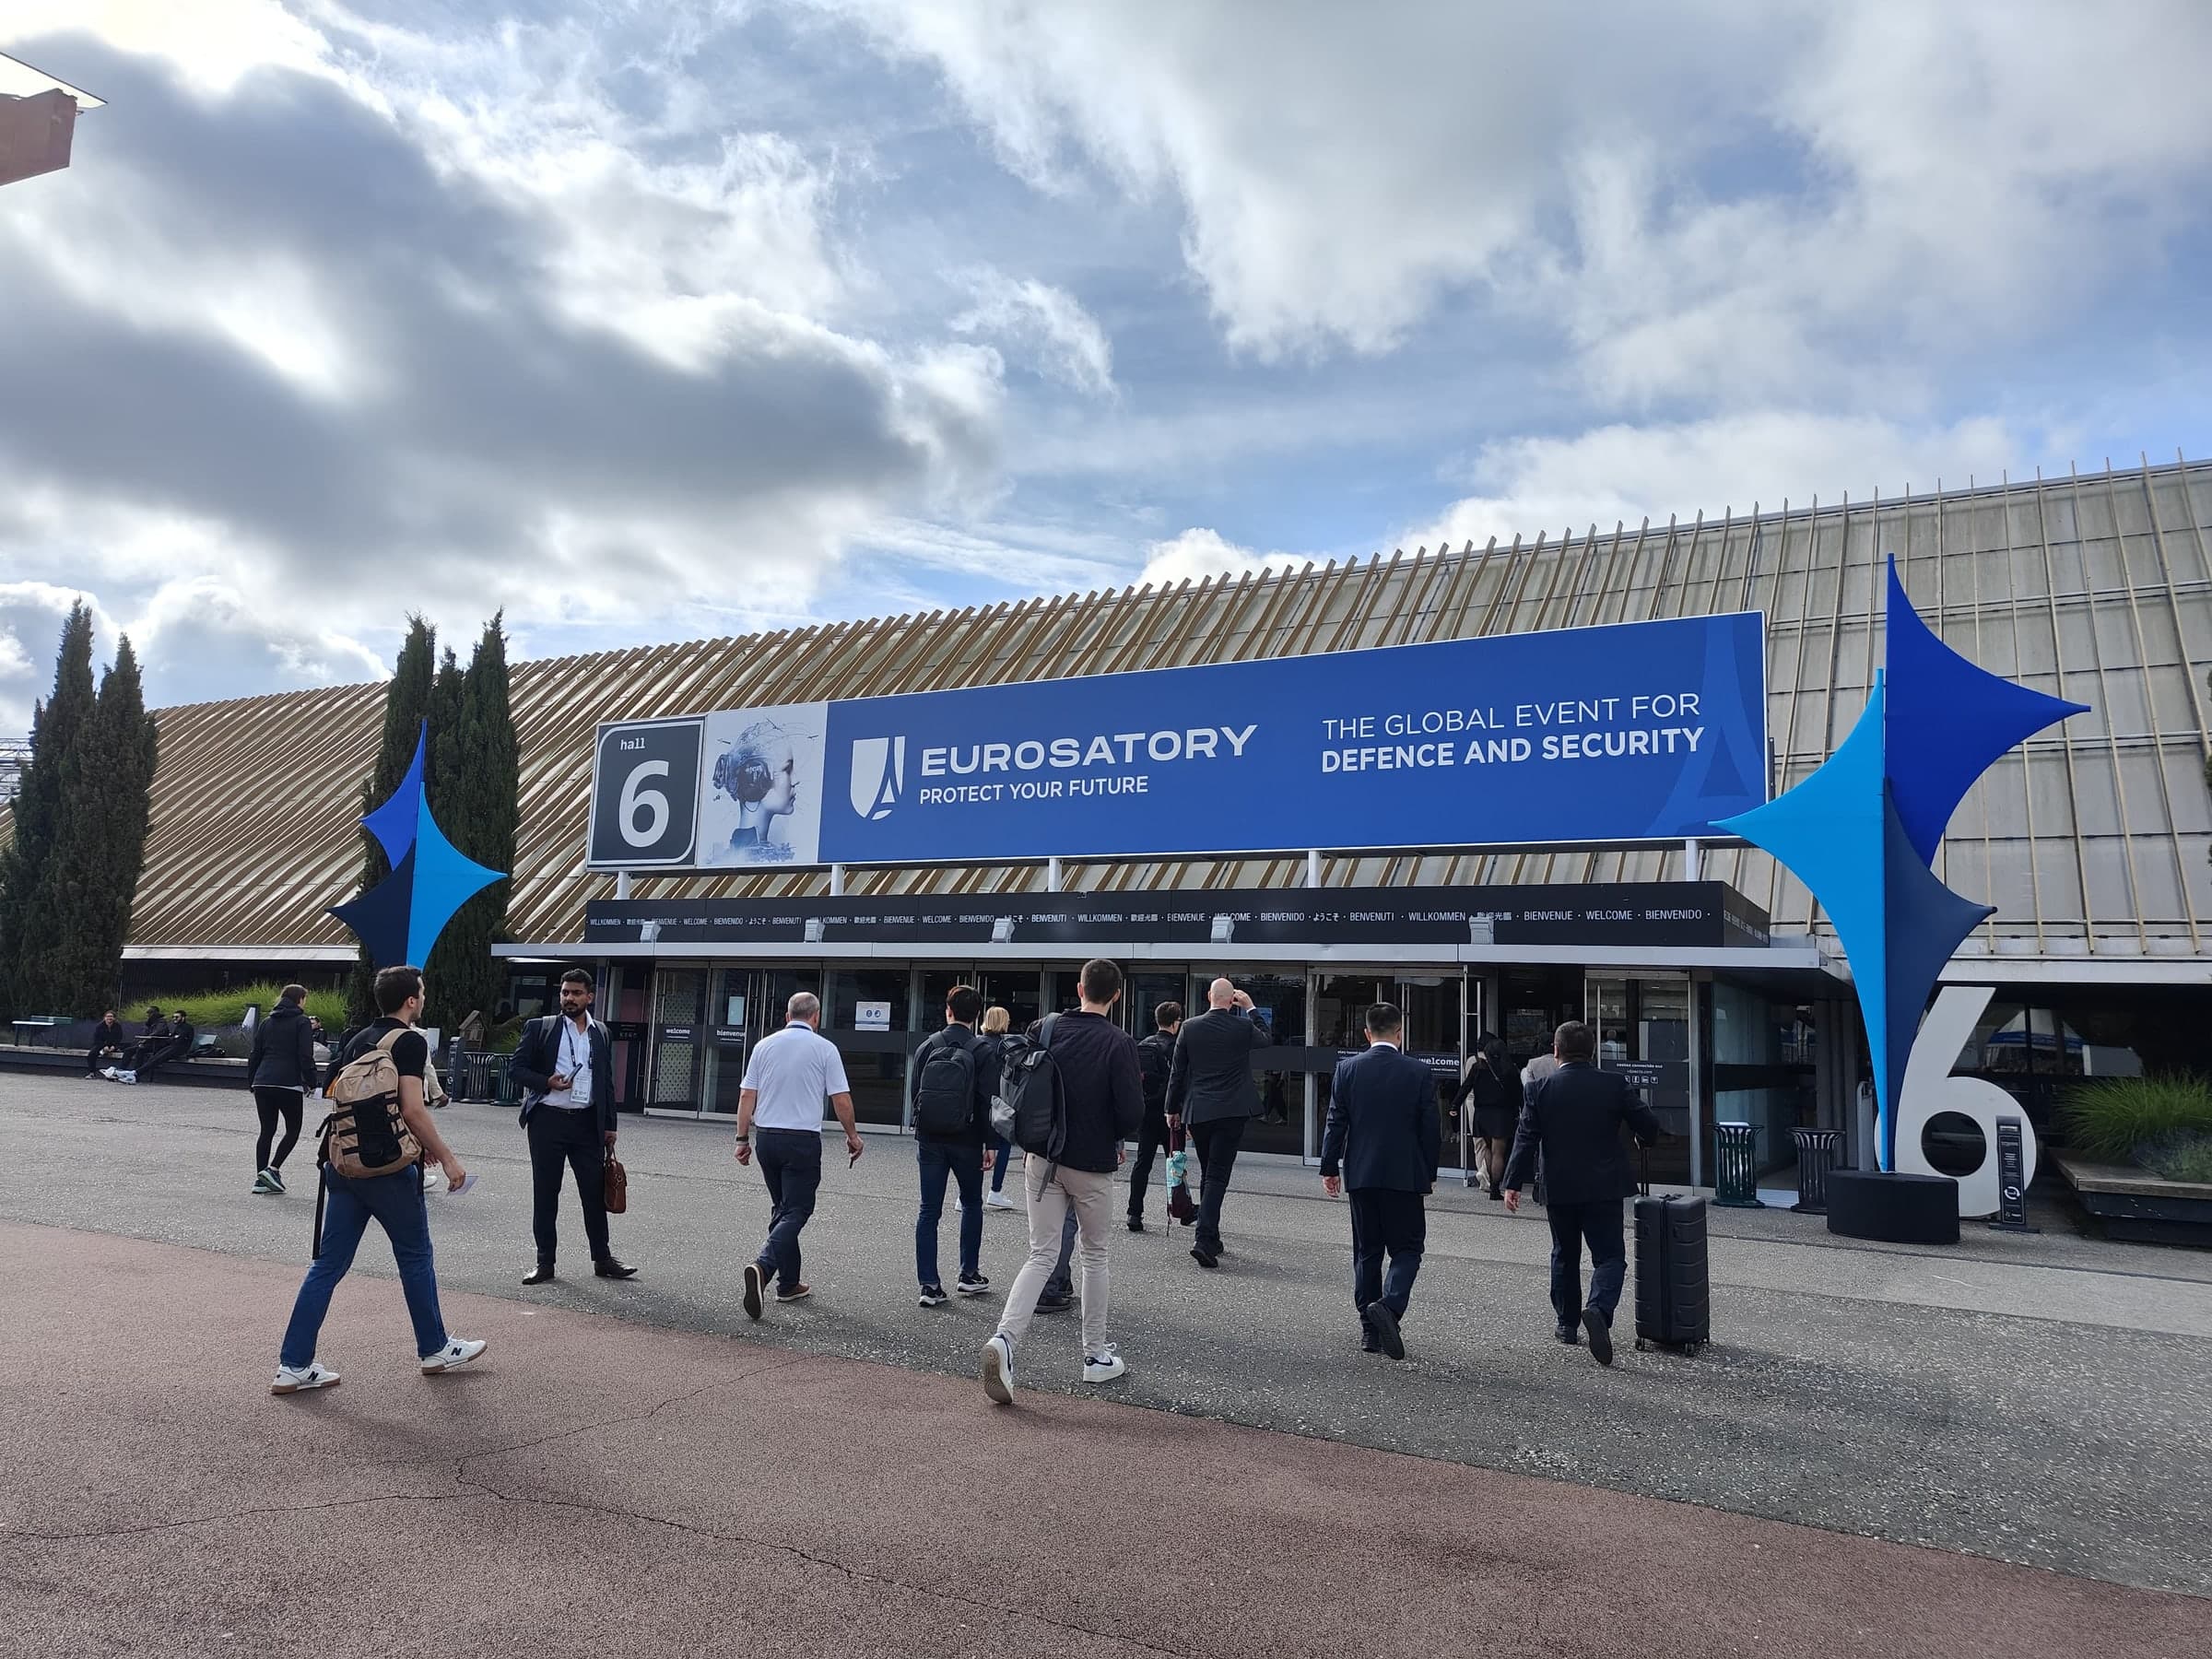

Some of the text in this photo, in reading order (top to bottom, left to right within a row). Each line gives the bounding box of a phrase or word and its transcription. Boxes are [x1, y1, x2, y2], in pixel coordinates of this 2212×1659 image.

[1323, 692, 1701, 740] THE GLOBAL EVENT FOR
[619, 737, 645, 751] hall
[921, 724, 1258, 777] EUROSATORY
[1322, 726, 1706, 773] DEFENCE AND SECURITY
[618, 759, 670, 848] 6
[920, 776, 1149, 805] PROTECT YOUR FUTURE
[772, 917, 802, 925] BENVENUTI
[923, 915, 952, 924] WELCOME
[1077, 913, 1123, 922] WILLKOMMEN
[1167, 913, 1206, 922] BIENVENUE
[1260, 912, 1305, 922] BIENVENIDO
[1312, 912, 1339, 922] ようこそ
[1349, 912, 1394, 921] BENVENUTI
[1408, 912, 1466, 921] WILLKOMMEN
[1524, 911, 1573, 921] BIENVENUE
[1585, 910, 1633, 920] WELCOME
[1645, 909, 1702, 920] BIENVENIDO
[1875, 986, 2036, 1217] 6
[450, 1347, 463, 1357] N
[307, 1371, 319, 1381] N
